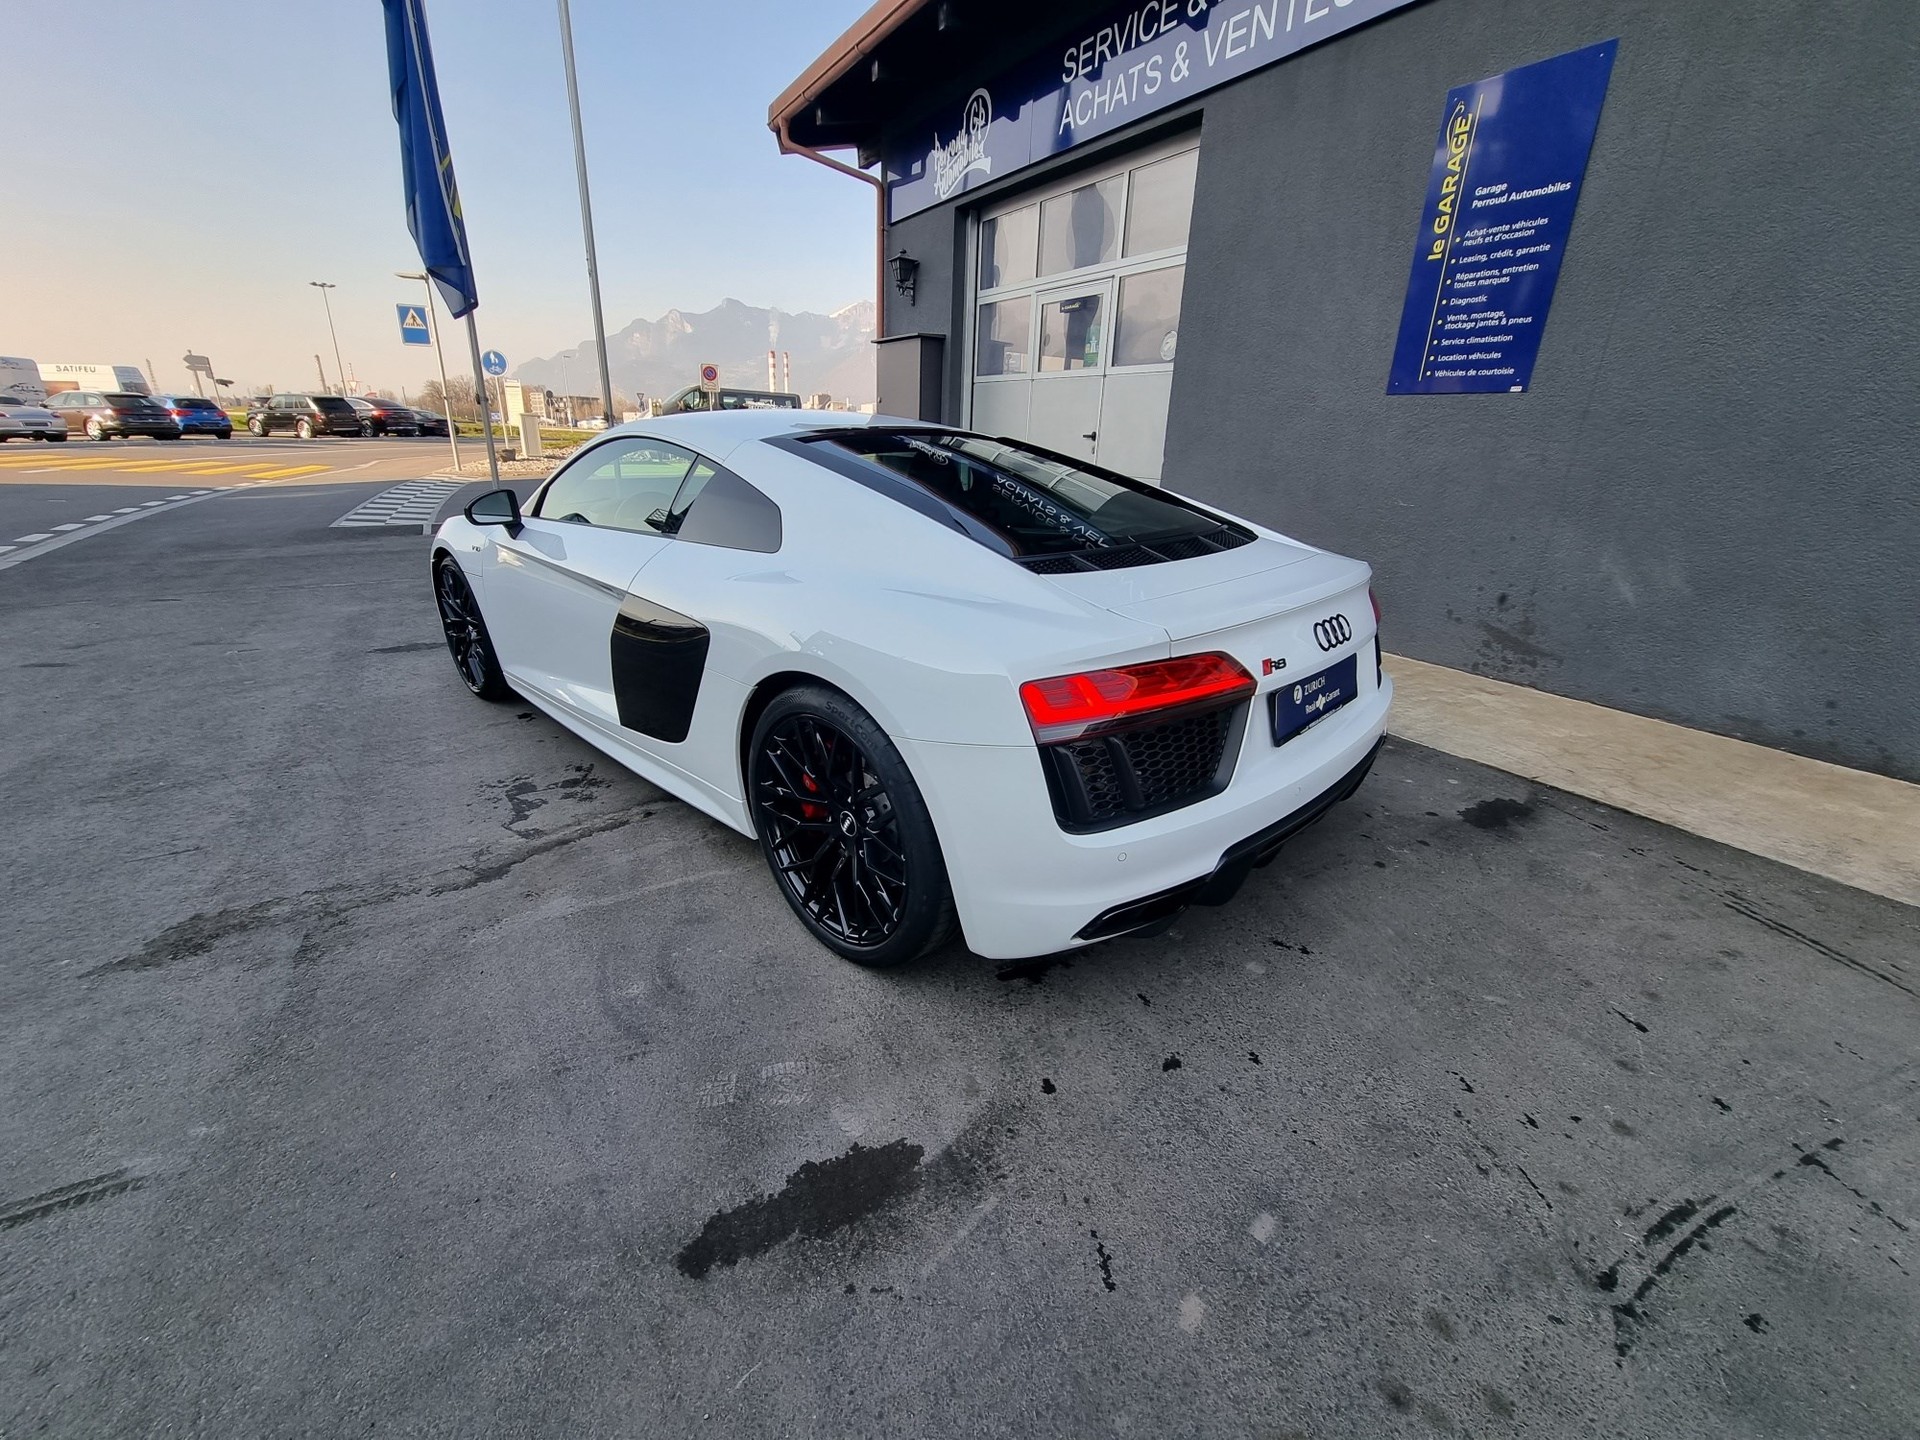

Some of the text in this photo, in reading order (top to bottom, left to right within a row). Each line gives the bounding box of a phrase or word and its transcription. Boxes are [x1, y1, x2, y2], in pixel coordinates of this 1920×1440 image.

[1062, 0, 1178, 83] SERVICE
[1058, 0, 1355, 135] ACHATS & VENT
[1427, 112, 1473, 261] le GARAGE
[1475, 182, 1508, 197] Garage
[1471, 181, 1572, 209] Perroud Automobiles
[1464, 217, 1549, 238] Achat-vente véhicules
[1463, 236, 1483, 247] neufs
[1484, 235, 1493, 243] et
[1458, 243, 1551, 264] Leasing, crédit, garantie
[1455, 262, 1539, 281] Réparations, entretien
[1454, 275, 1510, 289] toutes marques
[1449, 294, 1488, 306] Diagnostic
[1444, 316, 1532, 330] stockage jantes & pneus
[1446, 309, 1506, 322] Vente, montage,
[1441, 334, 1513, 346] Service climatisation
[1437, 351, 1502, 362] Location véhicules
[1434, 366, 1515, 377] Véhicules de courtoisie
[1303, 675, 1326, 696] ZURICH
